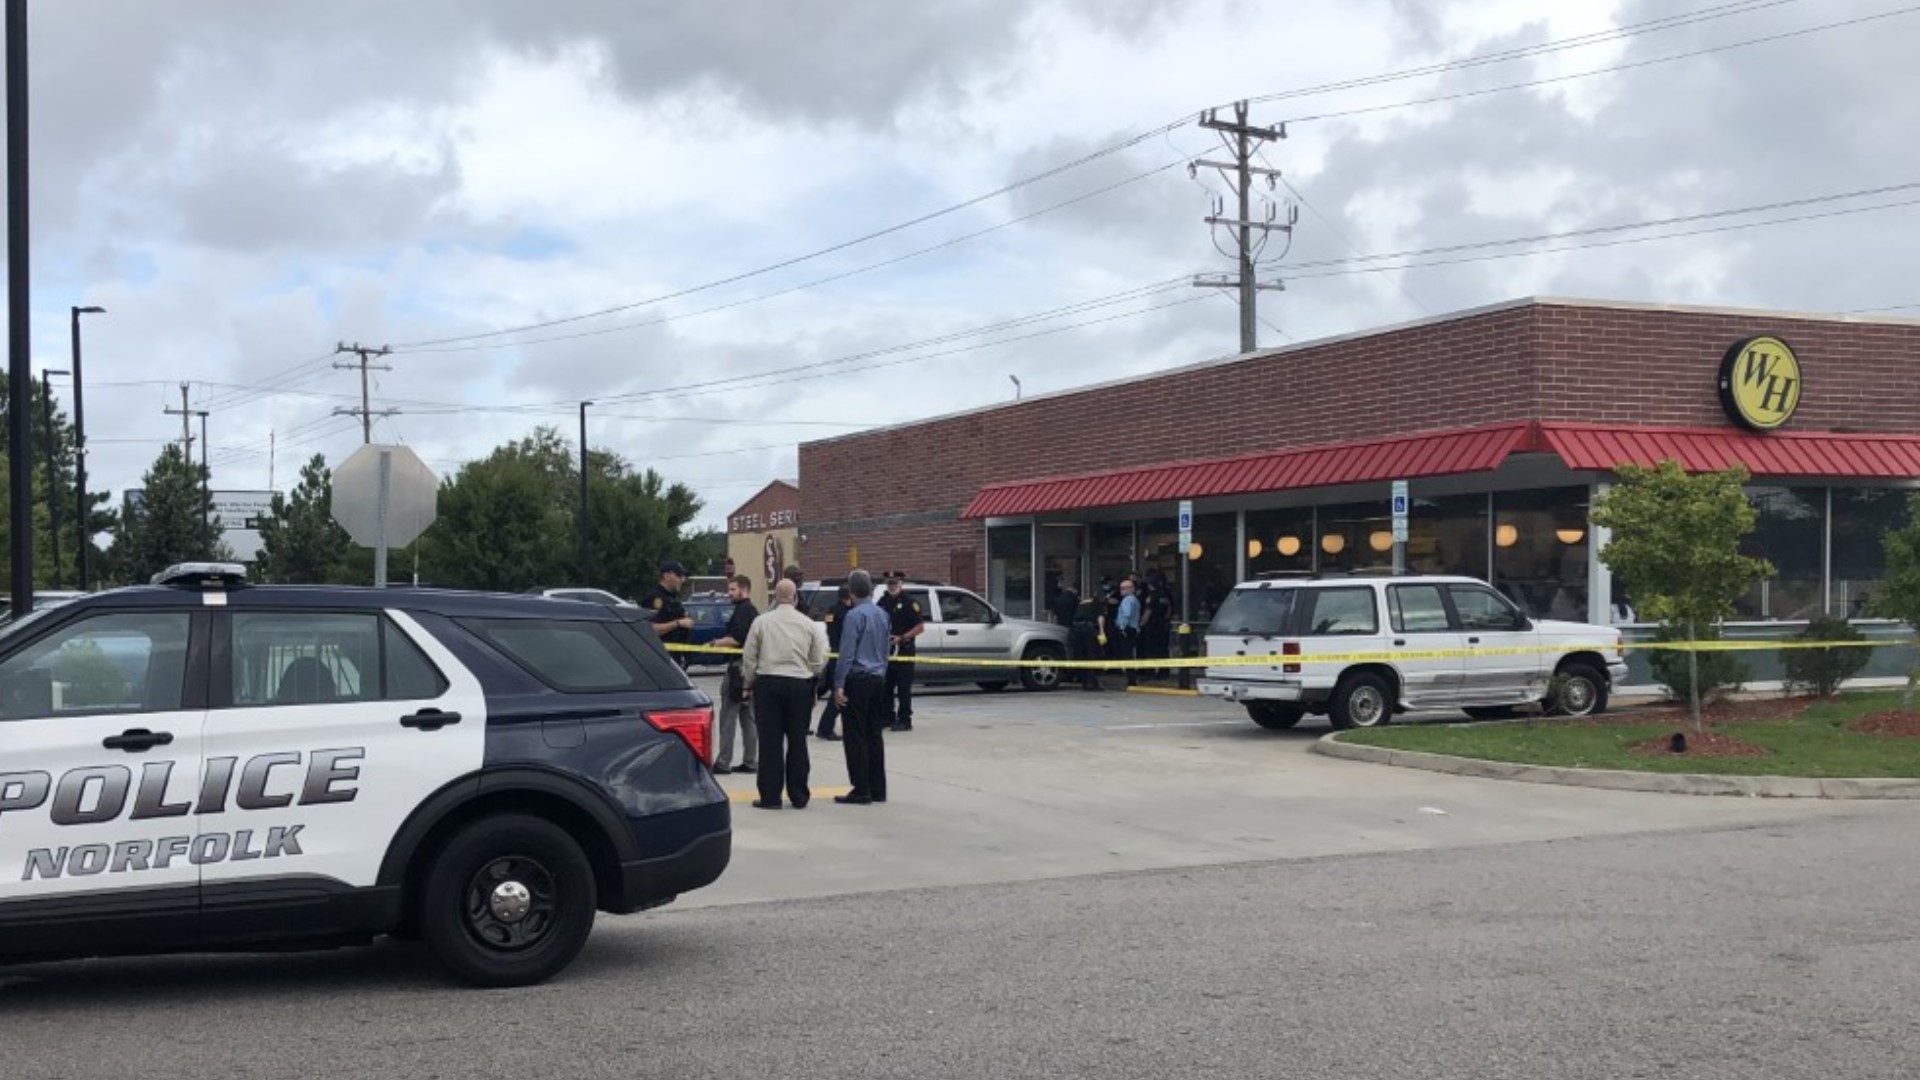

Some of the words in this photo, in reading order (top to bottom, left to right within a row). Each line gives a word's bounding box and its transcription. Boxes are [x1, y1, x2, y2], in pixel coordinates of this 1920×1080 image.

[1743, 351, 1797, 413] WH
[732, 513, 767, 530] STEEL
[0, 747, 365, 825] POLICE
[22, 825, 305, 880] NORFOLK
